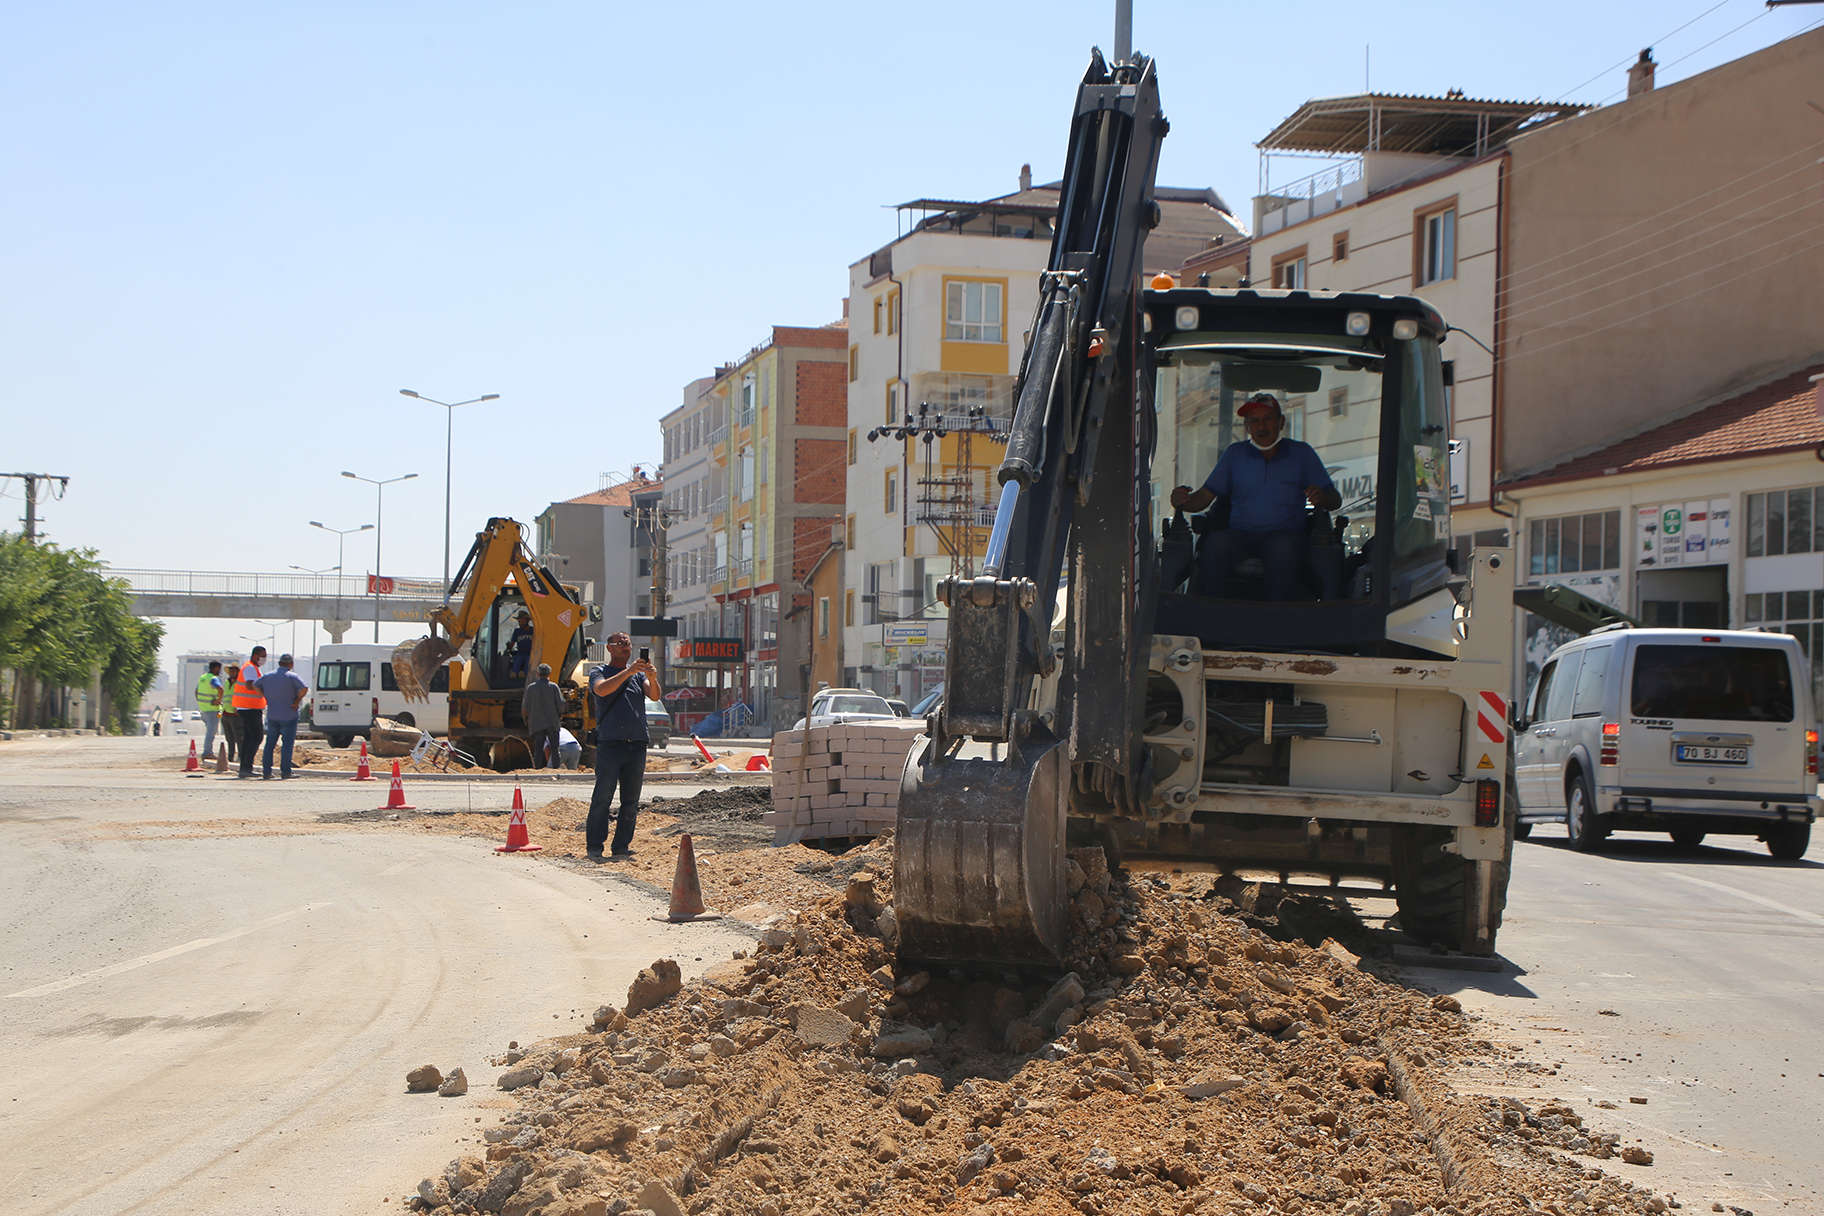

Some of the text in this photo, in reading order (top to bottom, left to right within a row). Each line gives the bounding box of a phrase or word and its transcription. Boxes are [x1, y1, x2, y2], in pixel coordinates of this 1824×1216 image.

[523, 566, 536, 581] CAT
[695, 642, 740, 657] MARKET
[1630, 718, 1673, 726] TOURNEO
[1684, 747, 1745, 760] 70 BJ 460
